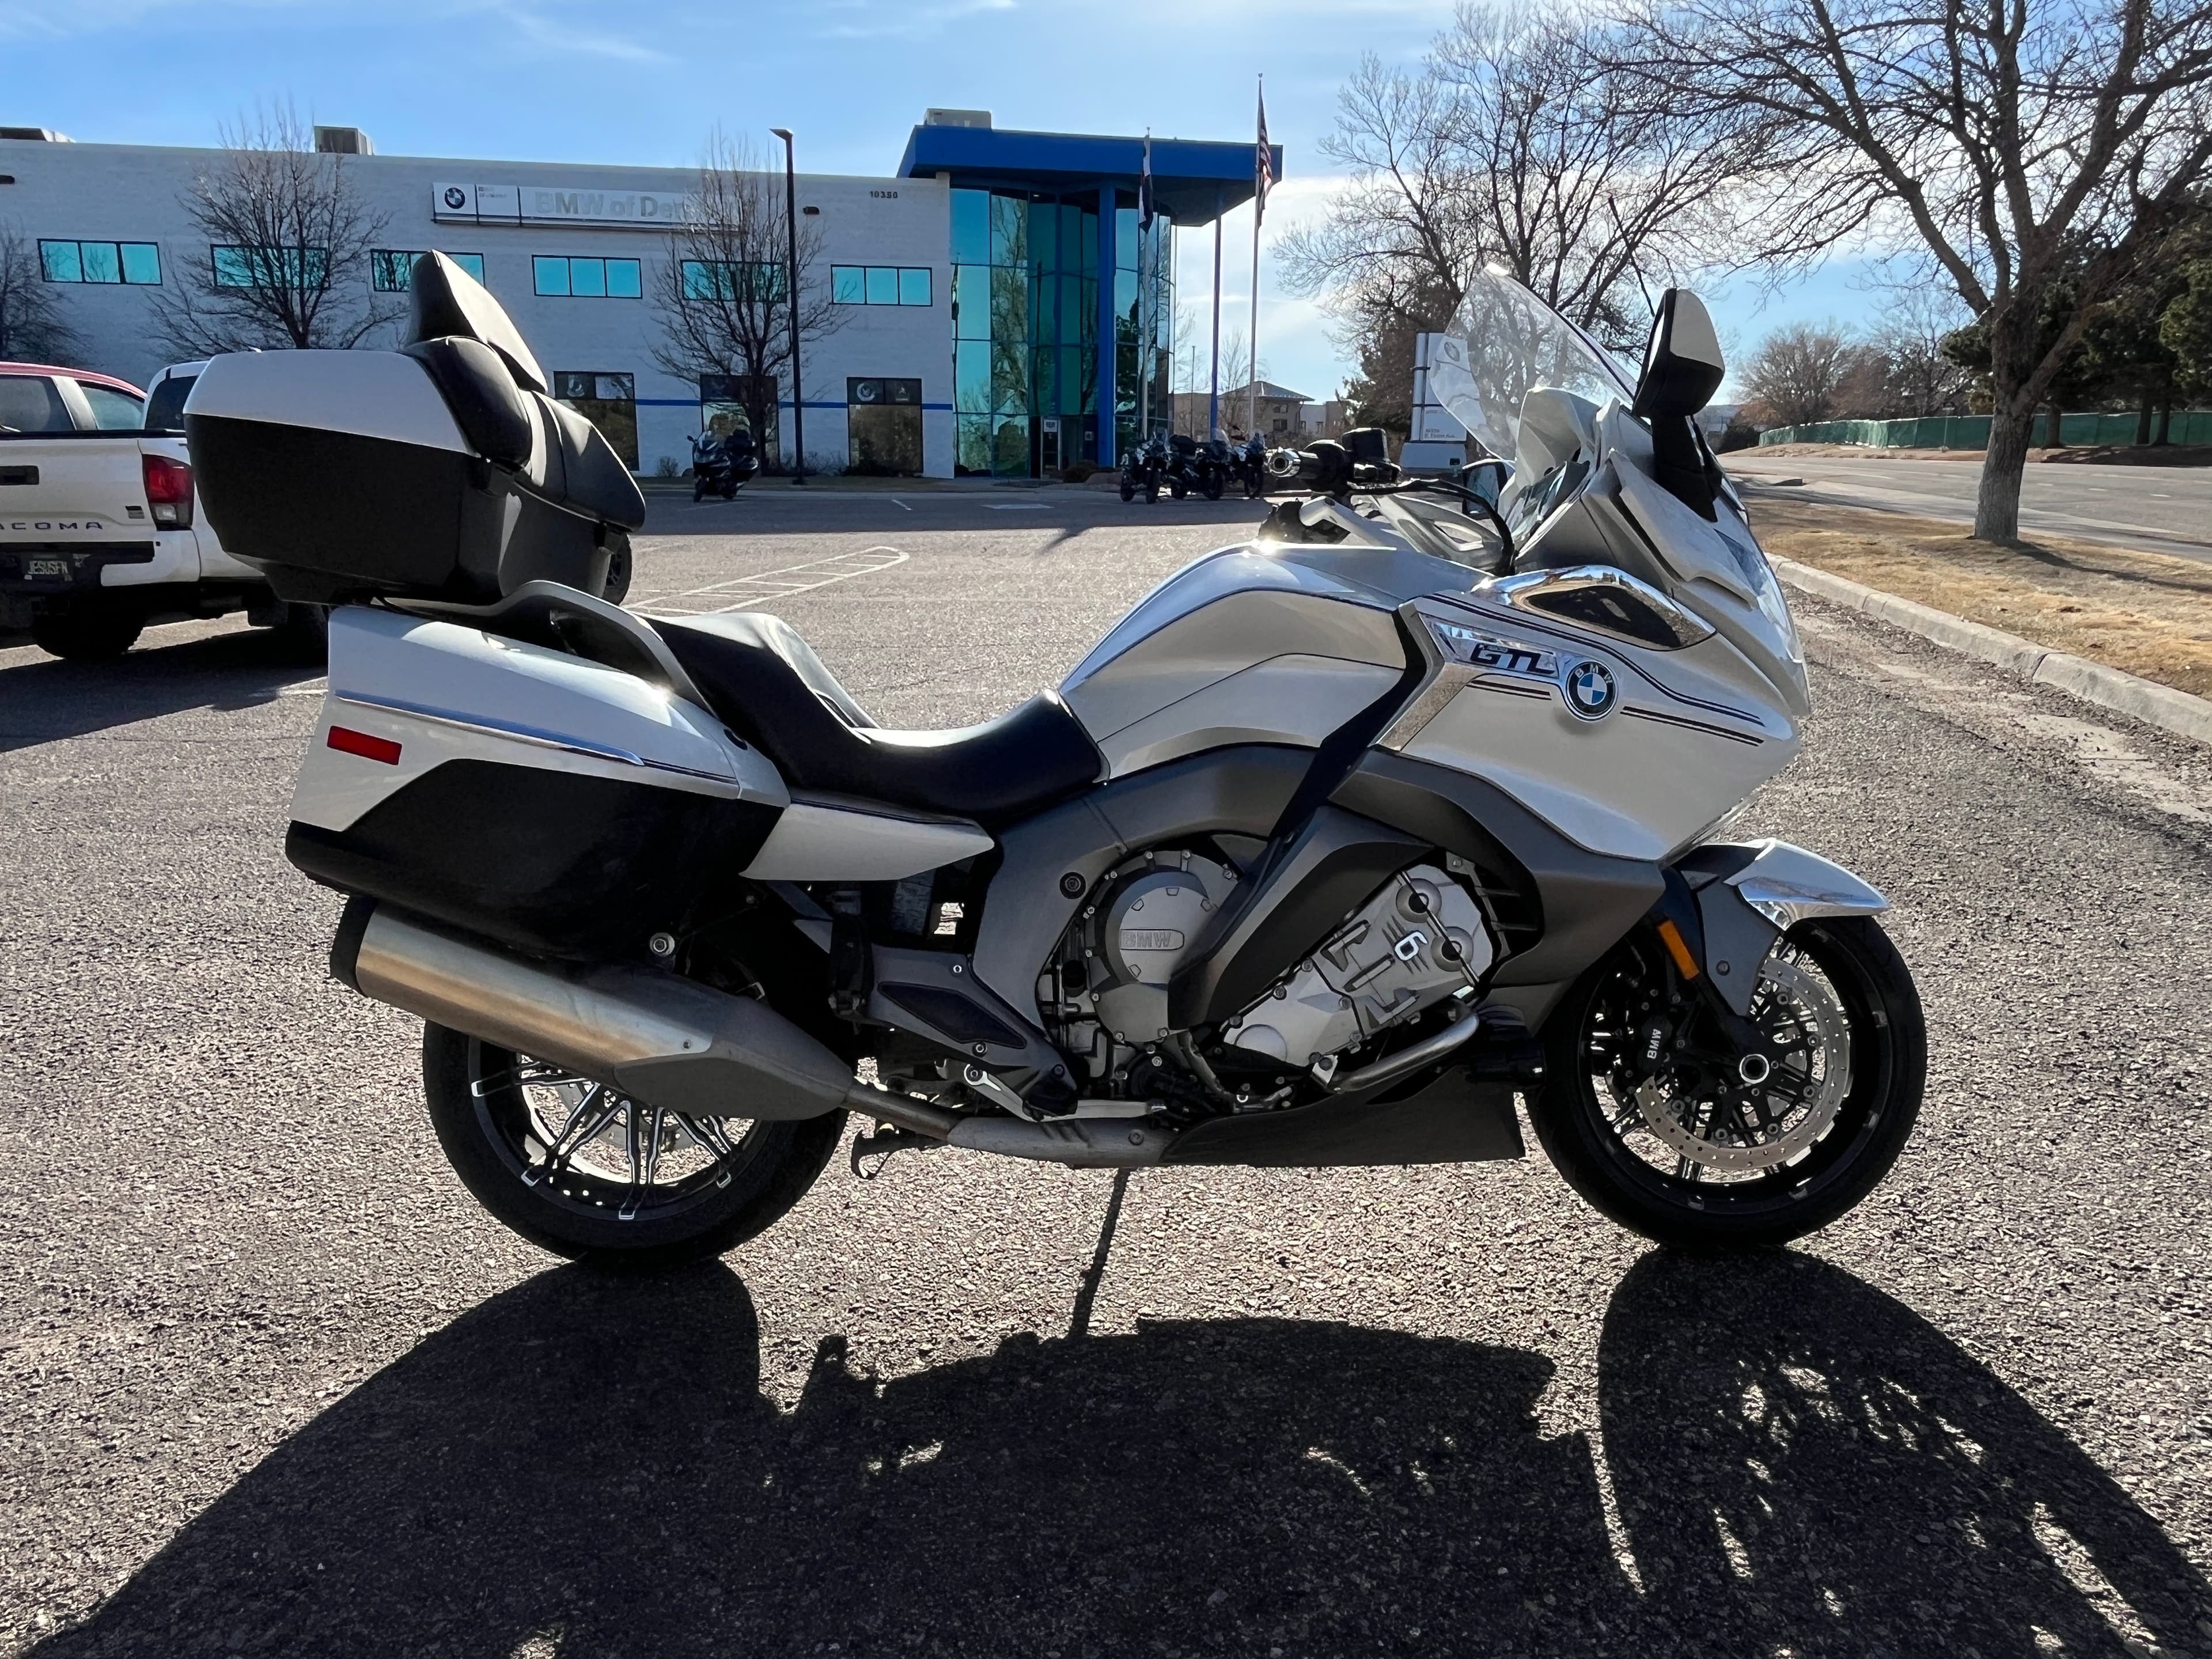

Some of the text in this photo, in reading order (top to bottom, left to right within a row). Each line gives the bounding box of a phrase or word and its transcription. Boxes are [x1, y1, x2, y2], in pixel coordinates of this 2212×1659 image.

[535, 192, 604, 215] BMW
[609, 196, 634, 217] of
[1470, 643, 1555, 674] GTL
[1574, 663, 1613, 684] BMW
[1123, 931, 1172, 948] BMW
[1647, 1028, 1661, 1059] BMW
